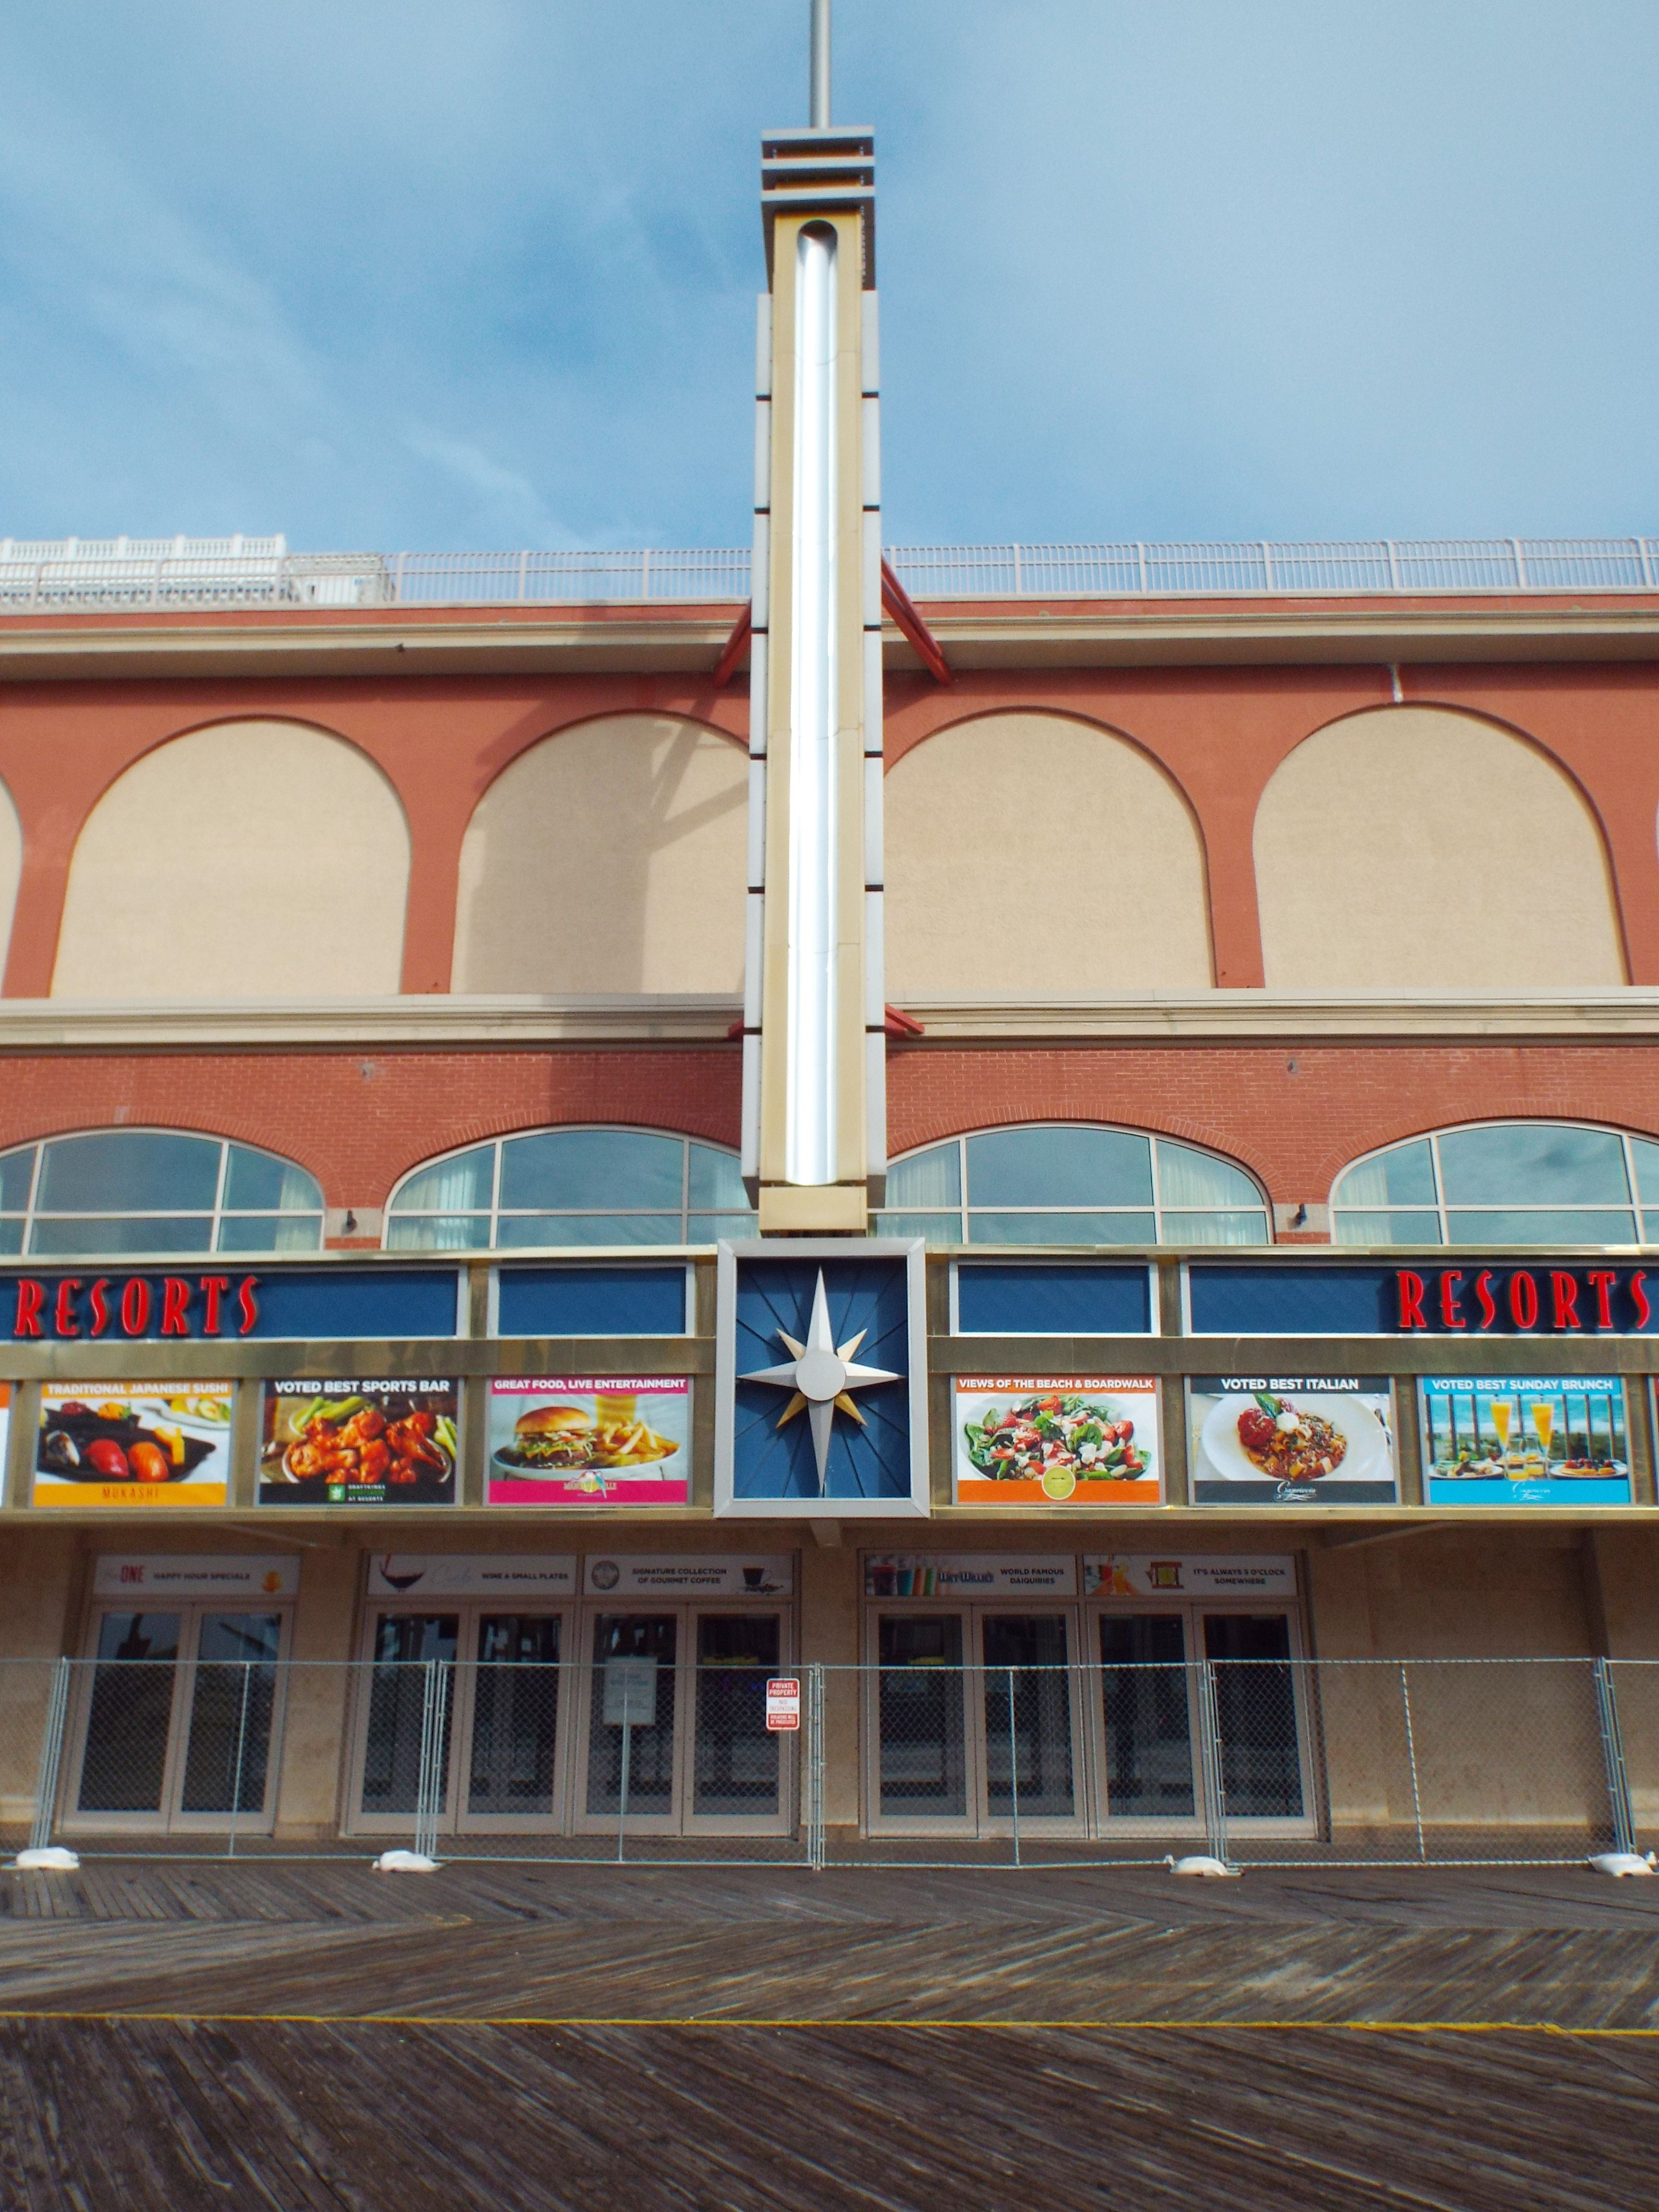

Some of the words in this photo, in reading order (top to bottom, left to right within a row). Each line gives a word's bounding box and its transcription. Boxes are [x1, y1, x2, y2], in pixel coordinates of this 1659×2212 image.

[13, 1275, 258, 1336] RESORTS
[1396, 1270, 1650, 1329] RESORTS
[49, 1383, 126, 1394] TRADITIONAL
[130, 1383, 190, 1393] JAPANESE
[193, 1382, 228, 1393] SUSHI
[274, 1381, 322, 1393] VOTED
[324, 1381, 360, 1393] BEST
[361, 1380, 417, 1392] SPORTS
[419, 1380, 450, 1392] BAR
[494, 1381, 530, 1390] GREAT
[531, 1380, 566, 1390] FOOD,
[568, 1380, 593, 1389] LIVE
[594, 1379, 685, 1389] ENTERTAINMENT
[959, 1379, 994, 1388] VIEWS
[996, 1379, 1011, 1388] OF
[1013, 1379, 1035, 1388] THE
[1036, 1379, 1073, 1388] BEACH
[1074, 1379, 1083, 1388] &
[1084, 1379, 1154, 1388] BOARDWALK
[1221, 1379, 1267, 1390] VOTED
[1270, 1379, 1303, 1390] BEST
[1306, 1379, 1359, 1390] ITALIAN
[1432, 1380, 1474, 1390] VOTED
[1476, 1380, 1507, 1390] BEST
[1510, 1380, 1559, 1390] SUNDAY
[1562, 1380, 1613, 1390] BRUNCH
[121, 1564, 144, 1583] ONE
